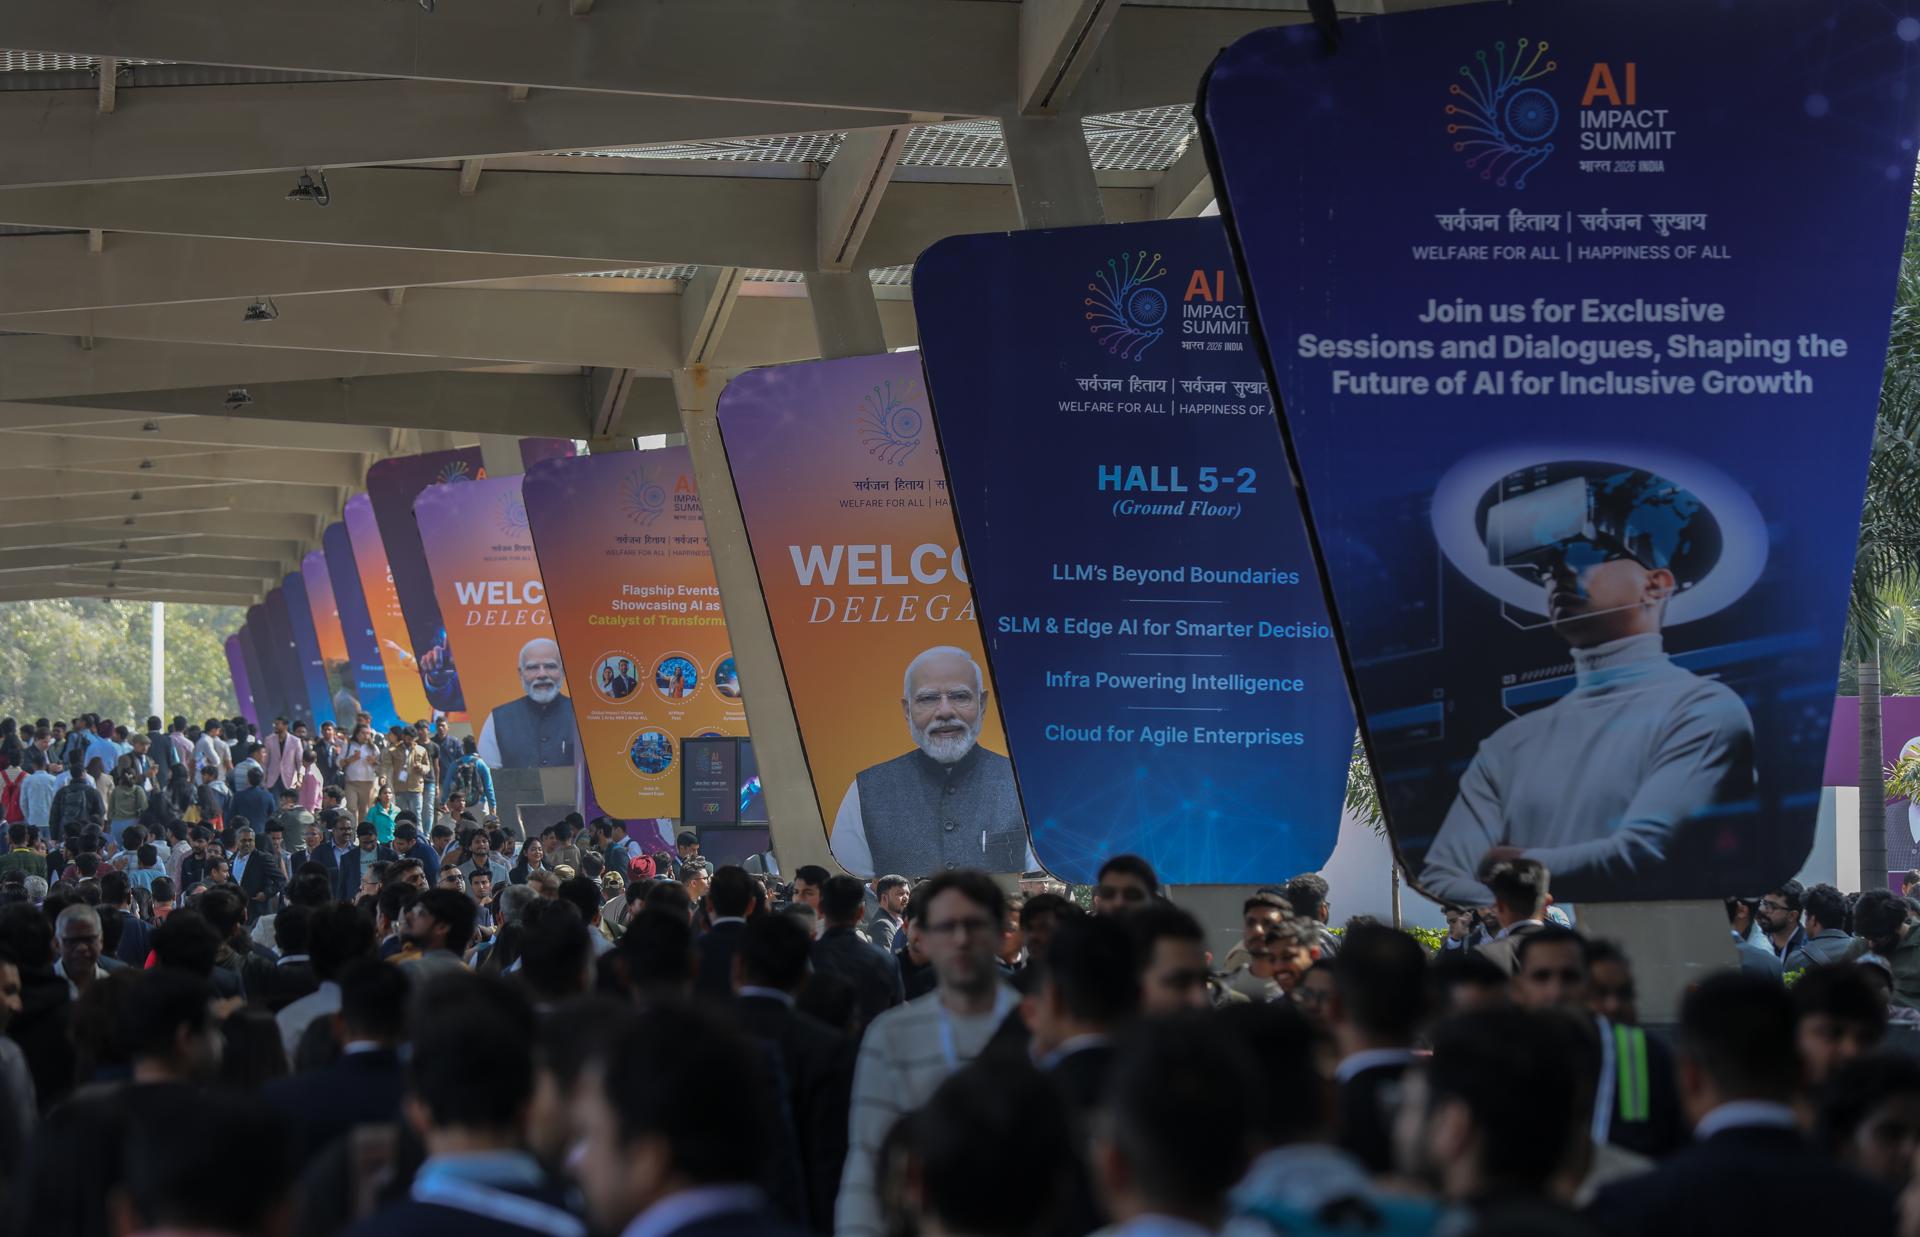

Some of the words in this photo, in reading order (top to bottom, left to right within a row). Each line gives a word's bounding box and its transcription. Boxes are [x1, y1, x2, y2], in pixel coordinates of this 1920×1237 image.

[1581, 62, 1636, 106] AI
[1580, 110, 1669, 128] IMPACT
[1580, 131, 1676, 150] SUMMIT
[1579, 160, 1611, 173] भारत
[1613, 160, 1636, 172] 2026
[1638, 161, 1665, 173] INDIA
[1436, 207, 1499, 232] सर्वजन
[1508, 207, 1560, 232] हिताय
[1577, 207, 1642, 232] सर्वजन
[1652, 211, 1706, 236] सुखाय
[1413, 246, 1490, 261] WELFARE
[1494, 246, 1525, 261] FOR
[1528, 246, 1560, 260] ALL
[1579, 245, 1668, 260] HAPPINESS
[1674, 245, 1696, 259] OF
[1700, 245, 1730, 259] ALL
[1184, 270, 1225, 302] AI
[1182, 304, 1246, 320] IMPACT
[1418, 300, 1482, 324] Join
[1489, 305, 1526, 323] us
[1532, 299, 1575, 323] for
[1581, 299, 1725, 323] Exclusive
[1182, 319, 1250, 335] SUMMIT
[1181, 340, 1204, 352] भारत
[1206, 341, 1223, 351] 2026
[1225, 342, 1243, 352] INDIA
[1298, 335, 1435, 359] Sessions
[1441, 335, 1496, 359] and
[1504, 335, 1660, 365] Dialogues,
[1667, 335, 1791, 364] Shaping
[1797, 335, 1847, 358] the
[1076, 375, 1123, 392] सर्वजन
[1129, 375, 1167, 393] हिताय
[1179, 375, 1225, 394] सर्वजन
[1332, 371, 1428, 395] Future
[1432, 371, 1467, 395] of
[1472, 371, 1504, 395] AI
[1510, 370, 1553, 395] for
[1560, 370, 1695, 394] Inclusive
[1702, 370, 1813, 394] Growth
[1059, 401, 1115, 413] WELFARE
[1117, 402, 1141, 413] FOR
[1144, 402, 1166, 413] ALL
[1179, 404, 1246, 415] HAPPINESS
[1249, 404, 1266, 415] OF
[853, 479, 889, 491] सर्वजन
[895, 477, 924, 491] हिताय
[1098, 465, 1188, 492] HALL
[1198, 466, 1257, 493] 5-2
[840, 500, 883, 508] WELFARE
[886, 499, 905, 507] FOR
[908, 499, 925, 507] ALL
[1112, 499, 1184, 516] (Ground
[1188, 501, 1241, 519] Floor)
[1112, 565, 1185, 585] Beyond
[1191, 568, 1299, 585] Boundaries
[623, 585, 674, 596] Flagship
[678, 586, 720, 595] Events
[612, 600, 687, 612] Showcasing
[690, 601, 703, 610] AI
[705, 603, 720, 611] as
[466, 610, 552, 626] DELEG
[588, 616, 641, 627] Catalyst
[644, 616, 656, 626] of
[998, 617, 1039, 634] SLM
[1046, 618, 1059, 634] &
[1064, 618, 1113, 638] Edge
[1118, 619, 1138, 635] AI
[1143, 619, 1170, 635] for
[1175, 620, 1252, 637] Smarter
[1046, 671, 1090, 688] Infra
[1096, 672, 1186, 693] Powering
[1192, 674, 1304, 694] Intelligence
[1045, 725, 1102, 742] Cloud
[1107, 725, 1134, 742] for
[1139, 726, 1188, 747] Agile
[1193, 728, 1304, 748] Enterprises
